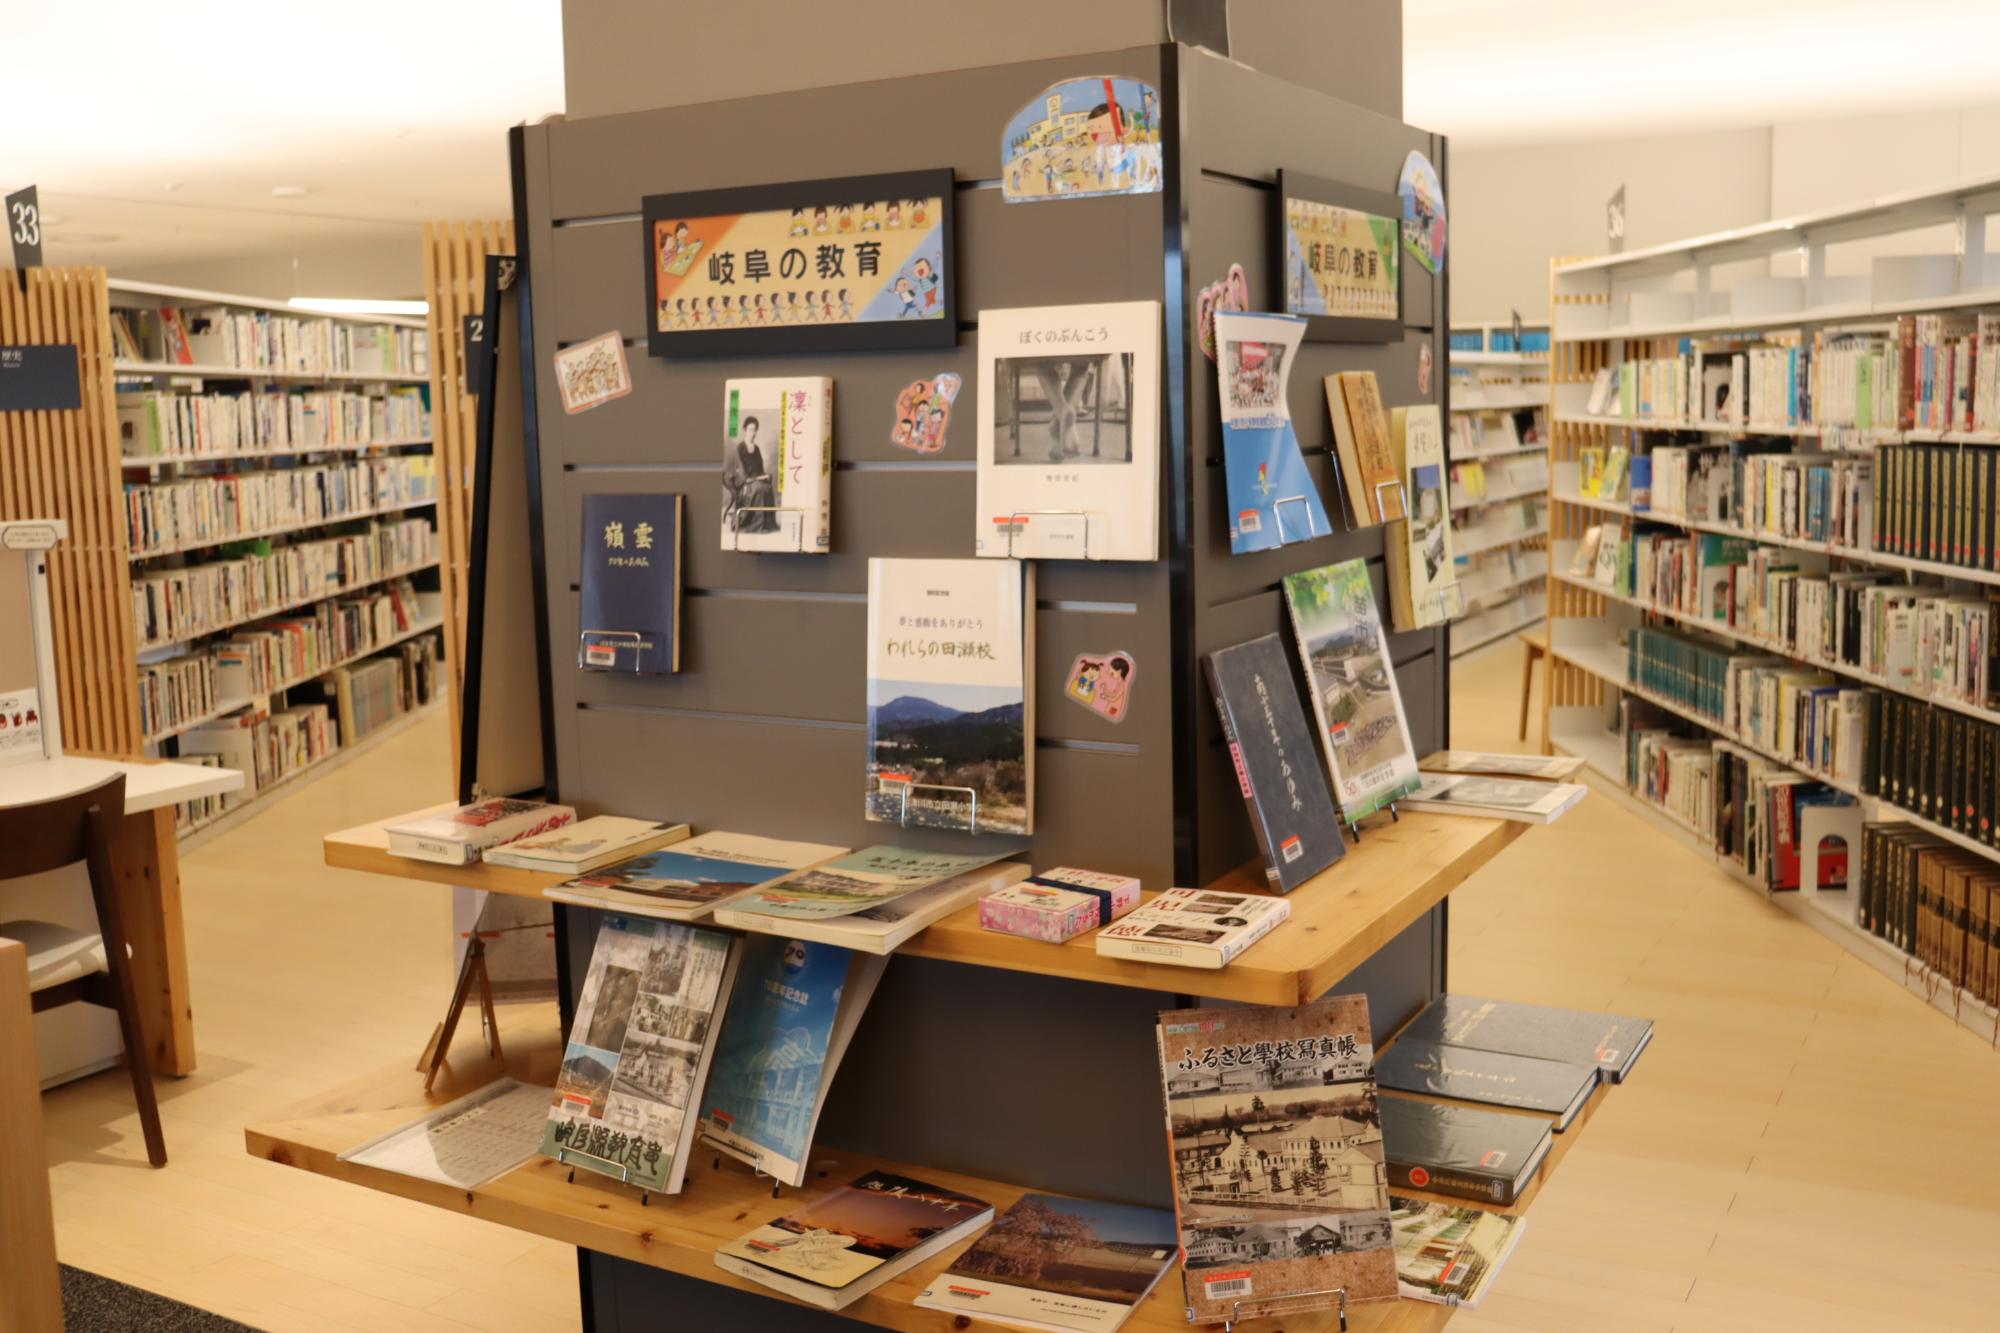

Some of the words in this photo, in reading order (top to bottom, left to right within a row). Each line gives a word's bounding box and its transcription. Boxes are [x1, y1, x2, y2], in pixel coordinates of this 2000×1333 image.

[12, 202, 40, 246] 33
[708, 241, 883, 286] 岐阜の教育
[1309, 239, 1379, 281] 岐阜の教育
[1019, 327, 1109, 345] ぼくのぶんこう
[898, 615, 984, 630] 夢と感動をありがとう
[886, 638, 998, 661] われらの田瀬校
